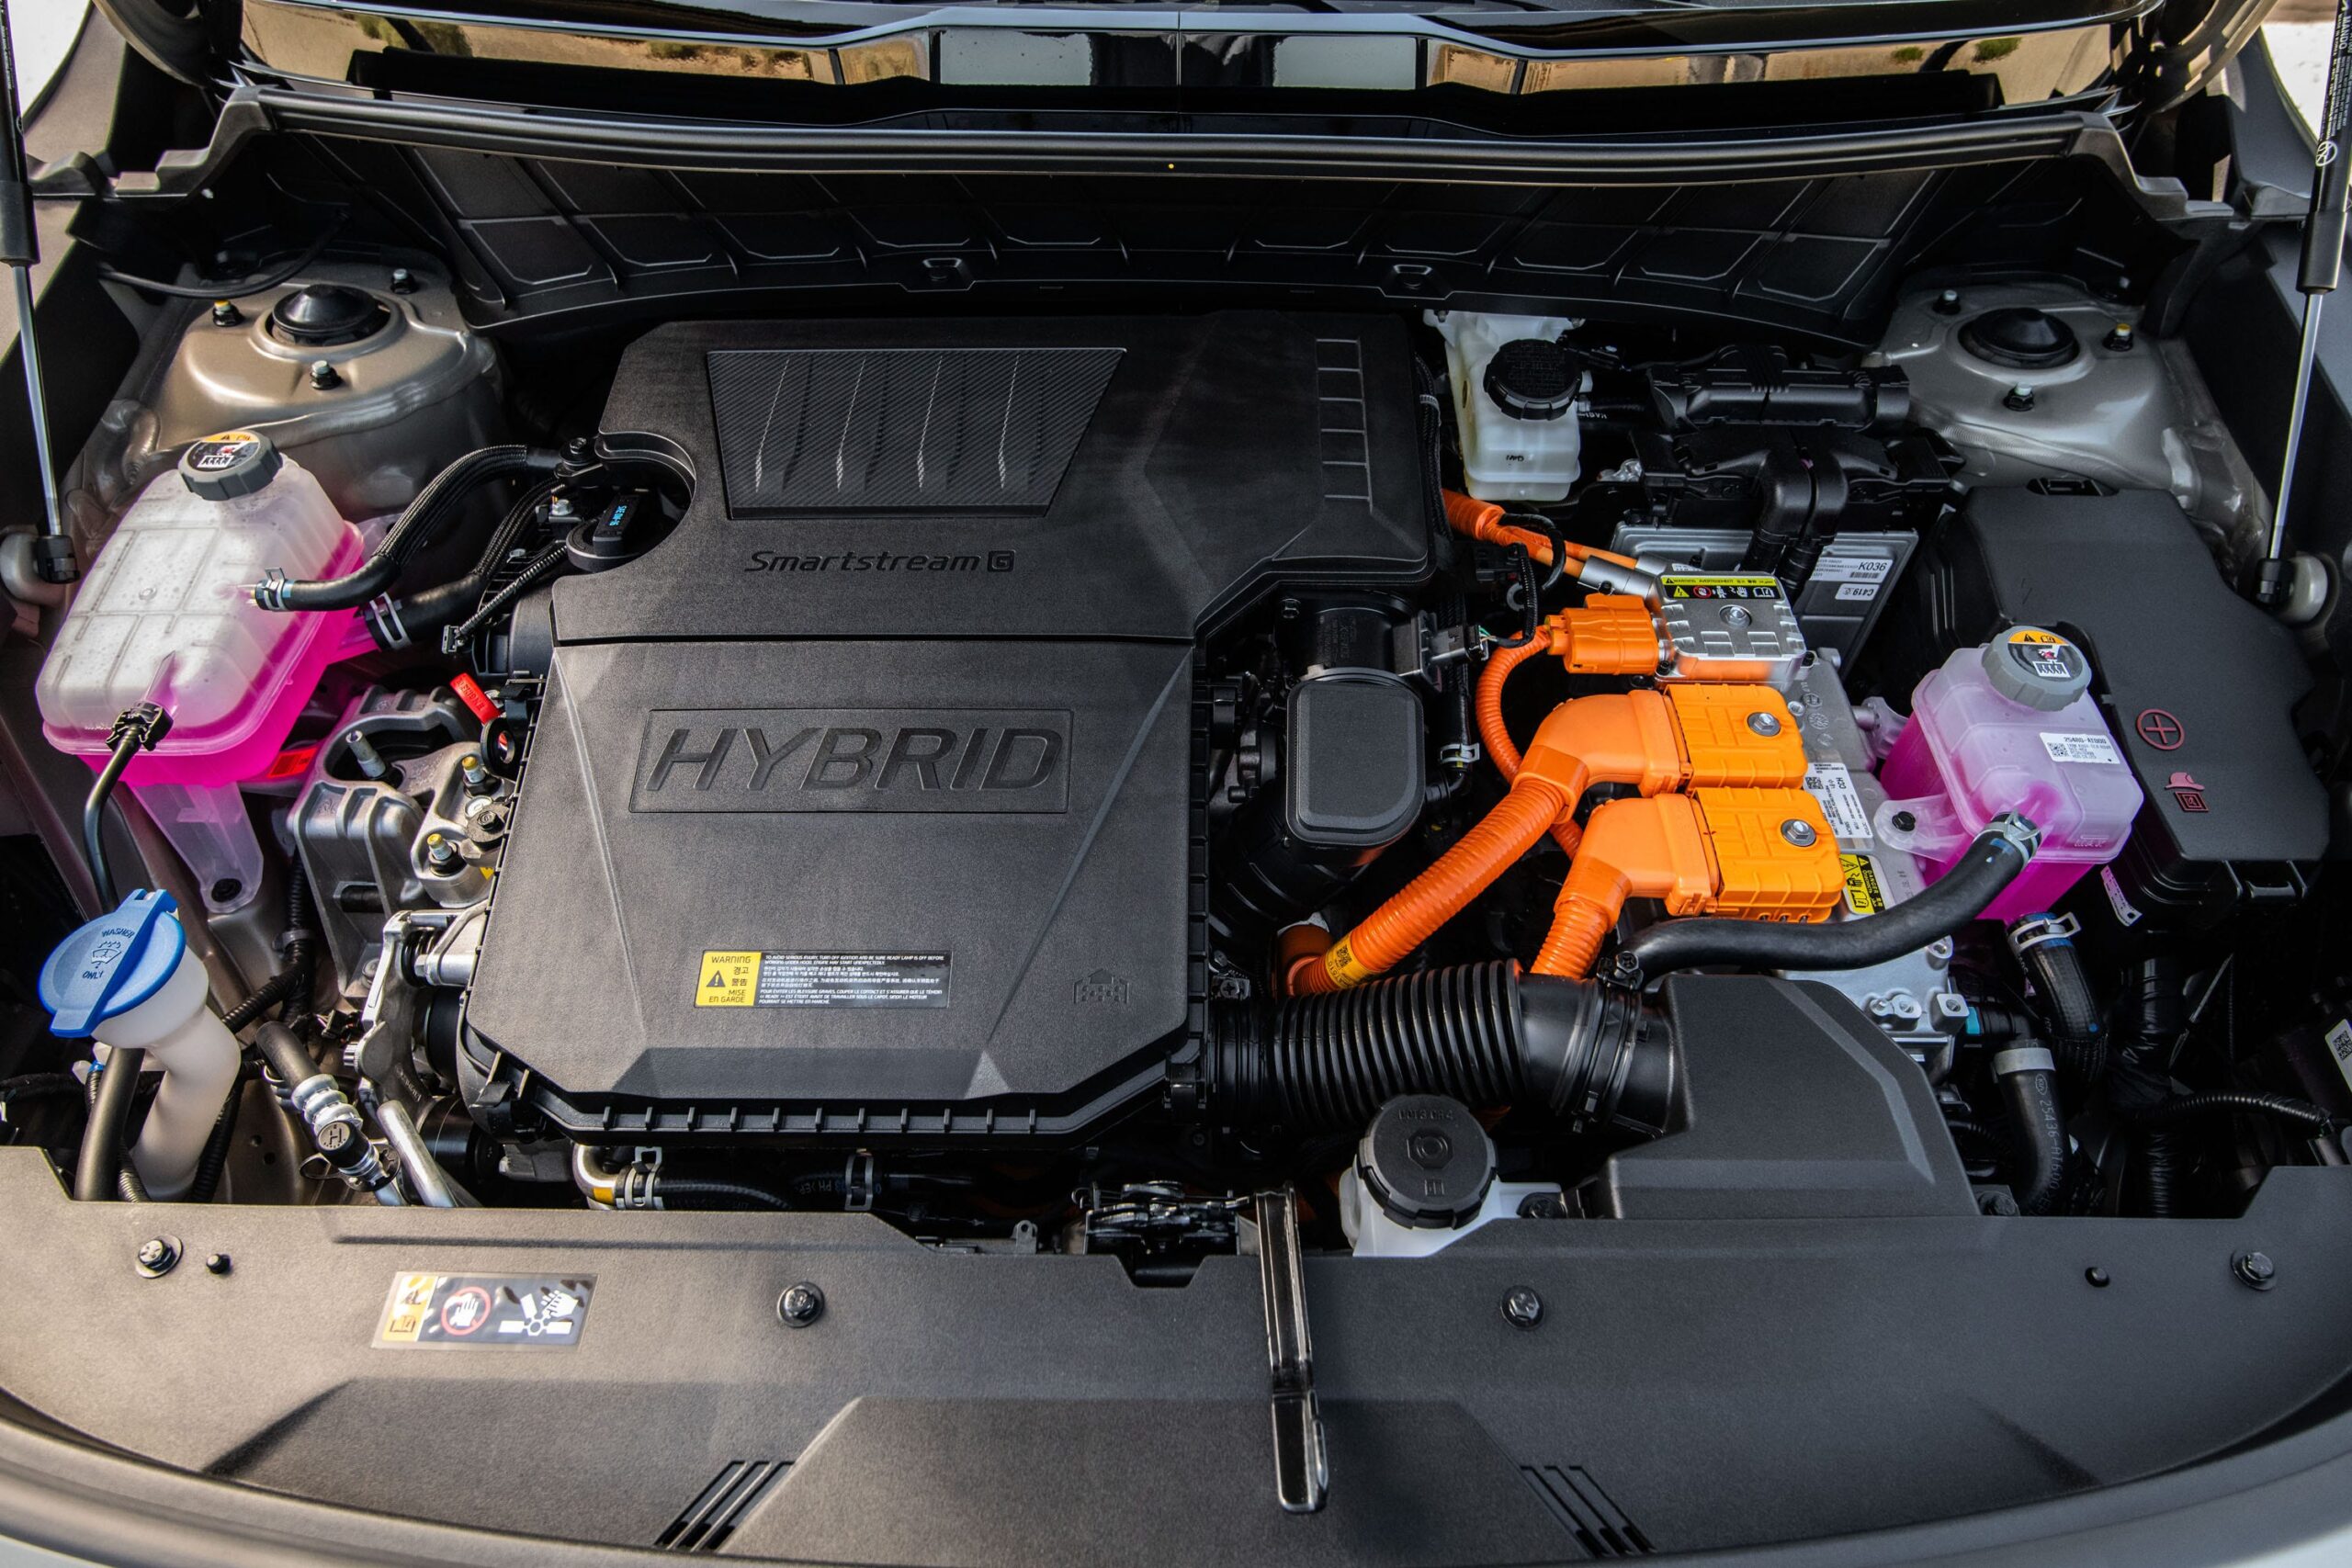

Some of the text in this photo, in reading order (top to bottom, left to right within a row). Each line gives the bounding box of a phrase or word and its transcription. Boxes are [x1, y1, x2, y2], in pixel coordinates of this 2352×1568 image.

[2339, 16, 2351, 49] MANDO
[744, 550, 981, 572] Smartstream
[1858, 562, 1887, 570] K036
[643, 728, 1063, 791] HYBRID
[1867, 870, 1879, 894] DANGER
[101, 928, 135, 938] WASHER
[82, 971, 104, 979] ONLY
[733, 966, 749, 976] 경고
[731, 977, 748, 987] 警告
